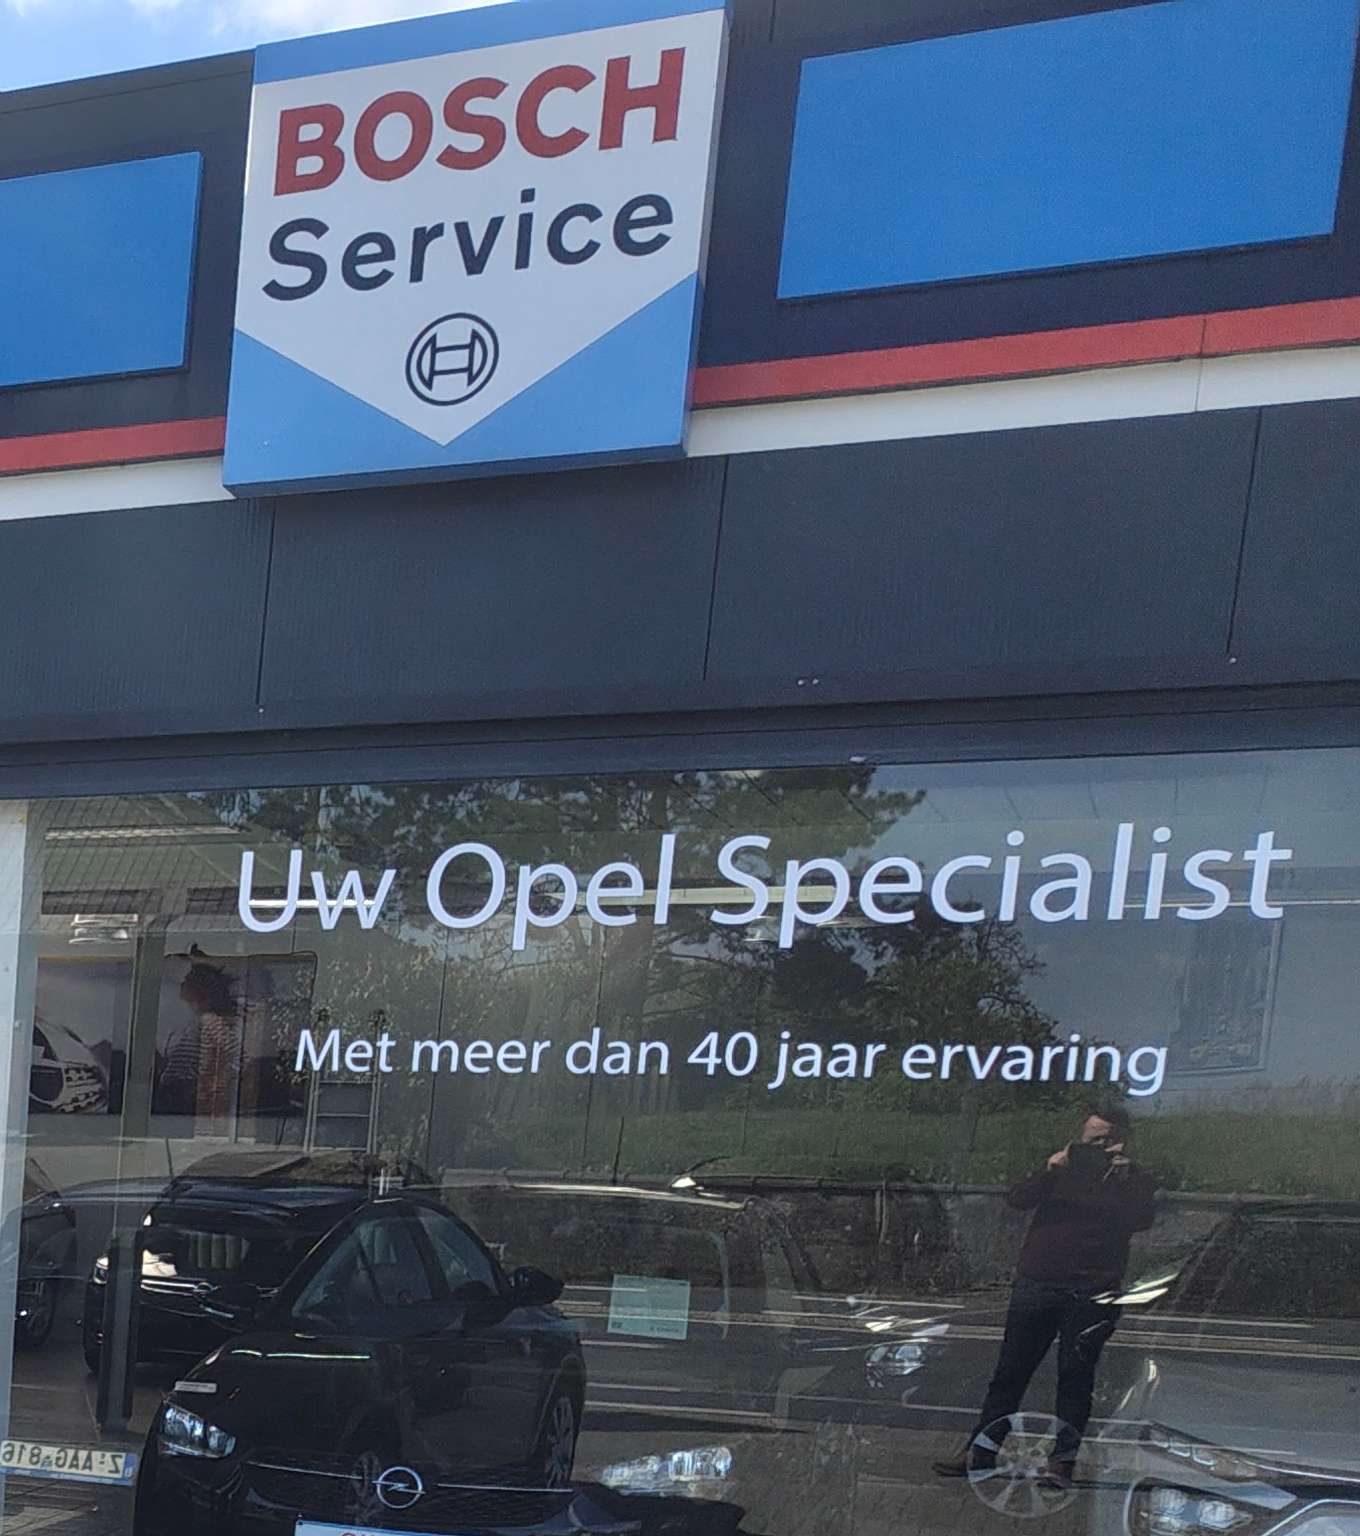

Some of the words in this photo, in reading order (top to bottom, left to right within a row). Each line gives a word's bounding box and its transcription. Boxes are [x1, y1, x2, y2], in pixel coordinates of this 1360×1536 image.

[274, 47, 686, 196] BOSCH
[262, 188, 673, 301] Service
[237, 850, 396, 933] Uw
[426, 833, 674, 950] Opel
[710, 823, 1293, 948] Specialist
[294, 1028, 396, 1074] Met
[410, 1038, 552, 1075] meer
[565, 1028, 670, 1075] dan
[686, 1031, 759, 1077] 40
[766, 1031, 887, 1090] jaar
[901, 1034, 1169, 1096] ervaring
